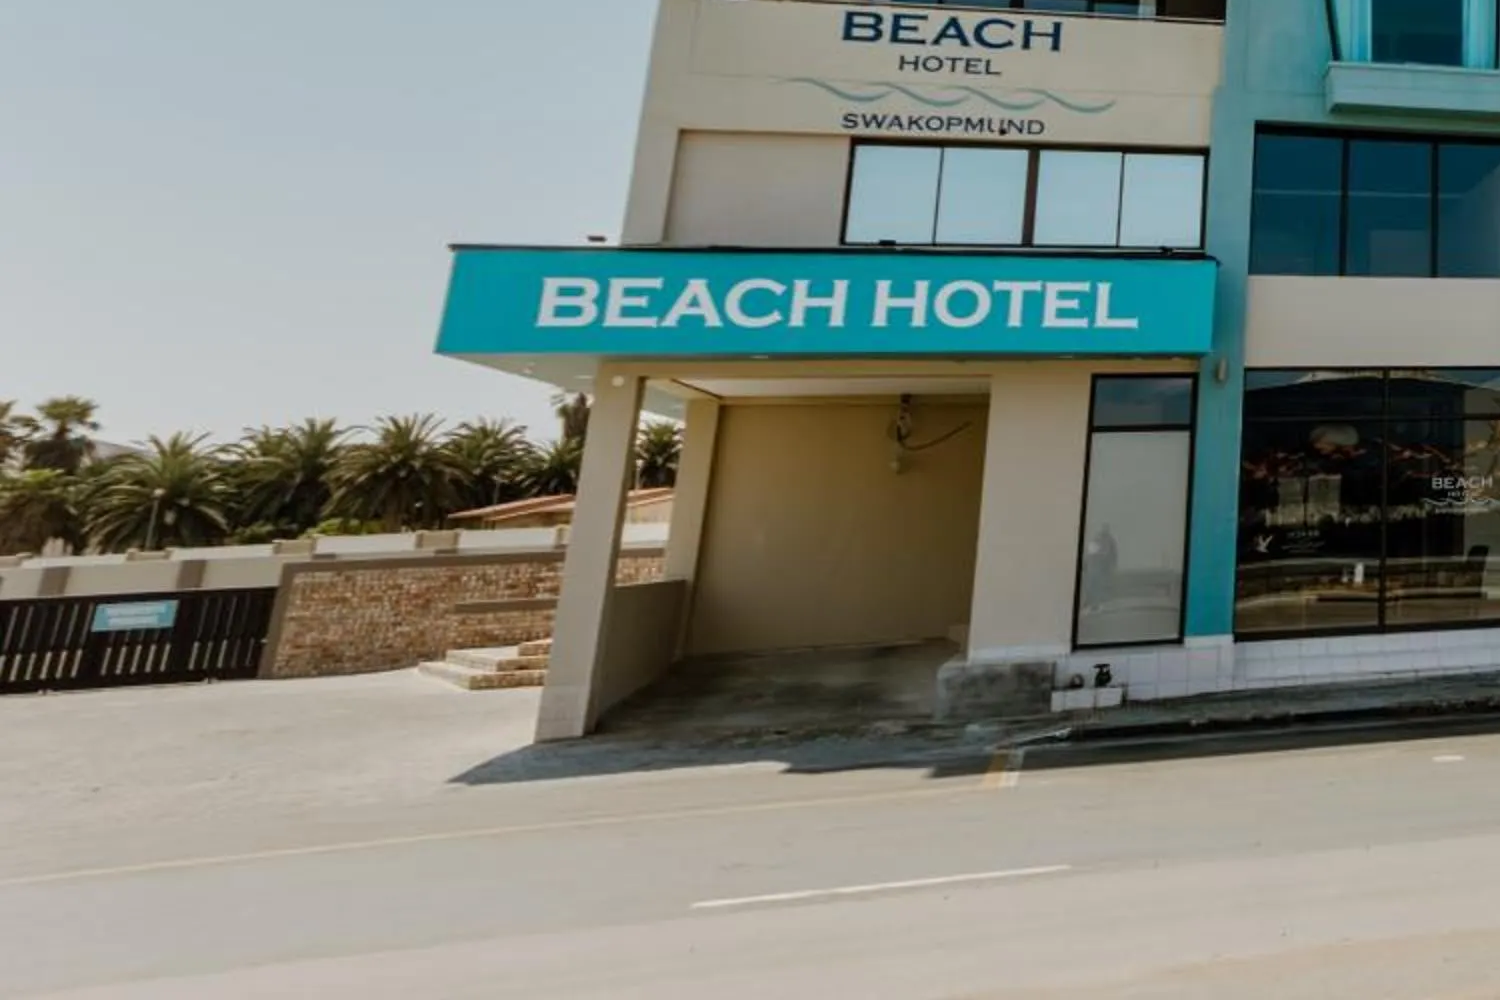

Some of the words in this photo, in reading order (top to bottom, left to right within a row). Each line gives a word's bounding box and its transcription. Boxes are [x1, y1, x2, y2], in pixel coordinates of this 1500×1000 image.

[841, 11, 1062, 52] BEACH
[898, 55, 1002, 76] HOTEL
[841, 112, 1045, 136] SWAKOPMUND
[535, 277, 849, 329] BEACH
[870, 279, 1140, 330] HOTEL
[1431, 476, 1493, 489] BEACH
